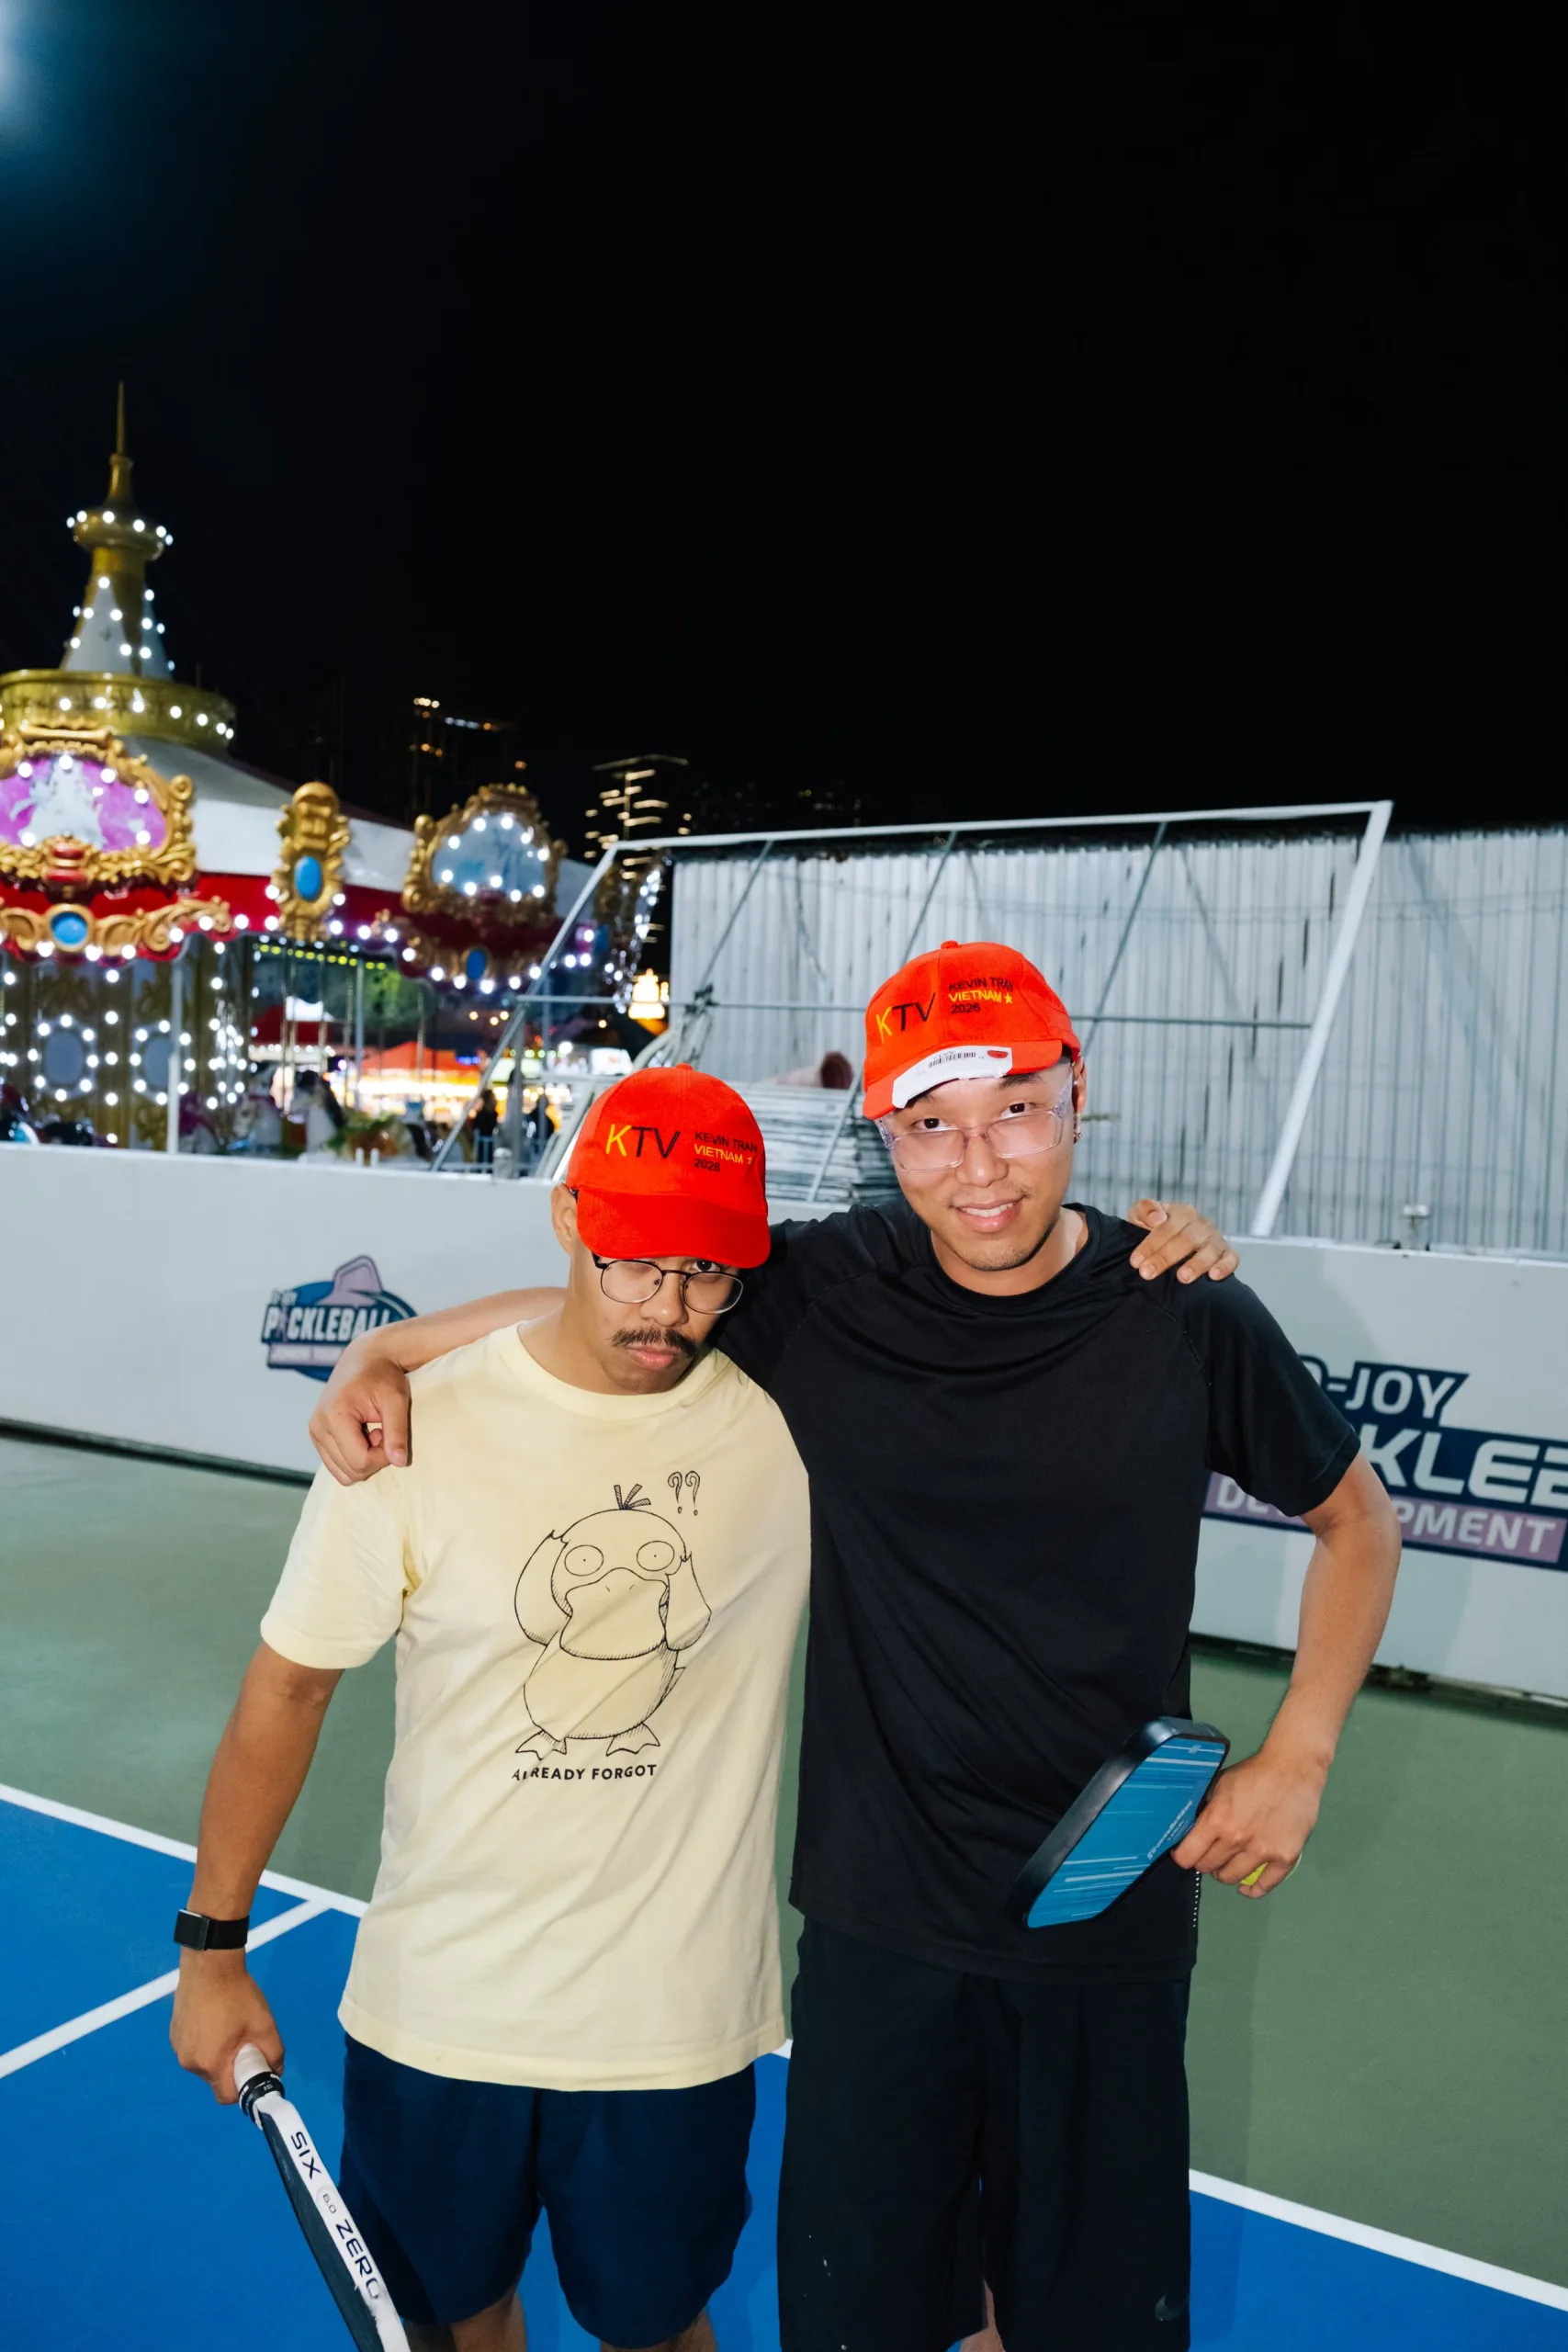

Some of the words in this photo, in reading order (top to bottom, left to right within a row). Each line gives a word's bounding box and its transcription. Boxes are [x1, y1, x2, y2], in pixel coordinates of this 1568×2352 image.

[949, 978, 987, 991] KEVIN
[990, 977, 1013, 992] TRAN
[948, 989, 1002, 1003] VIETNAM
[875, 992, 936, 1044] KTV
[951, 1003, 981, 1015] 2026
[605, 1124, 681, 1159] KTV
[694, 1131, 729, 1148] KEVIN
[732, 1138, 757, 1153] TRAN
[694, 1144, 743, 1164] VIETNAM
[694, 1158, 720, 1171] 2026
[1217, 1476, 1555, 1555] DPMENT
[592, 1764, 657, 1780] FORGOT
[290, 2132, 321, 2179] SIX
[321, 2193, 336, 2214] 6.0
[336, 2219, 380, 2299] ZERO
